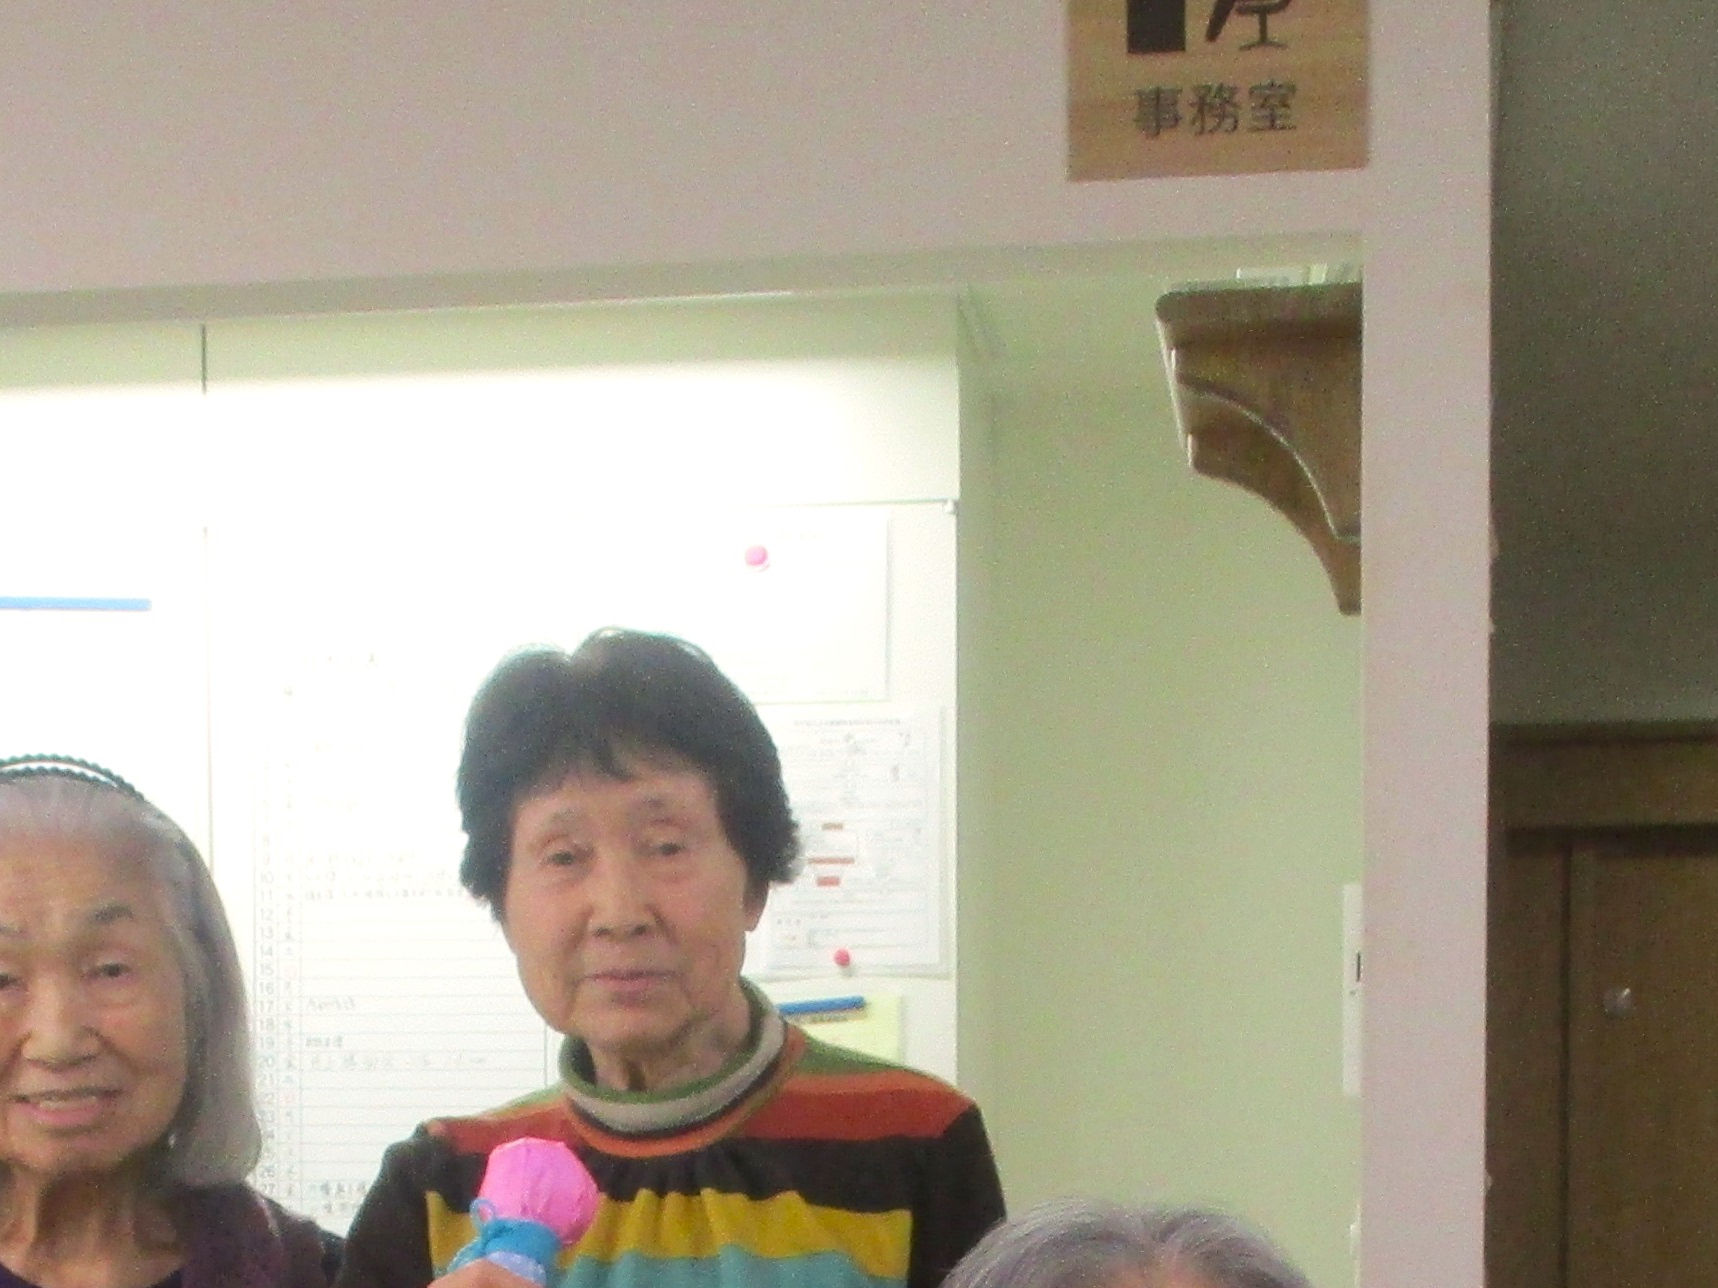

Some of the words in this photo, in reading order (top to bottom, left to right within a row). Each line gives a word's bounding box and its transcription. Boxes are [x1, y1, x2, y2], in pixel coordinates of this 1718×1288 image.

[1133, 80, 1298, 137] 事務室
[260, 944, 274, 957] 14
[260, 963, 274, 976] 15
[260, 981, 274, 994] 16
